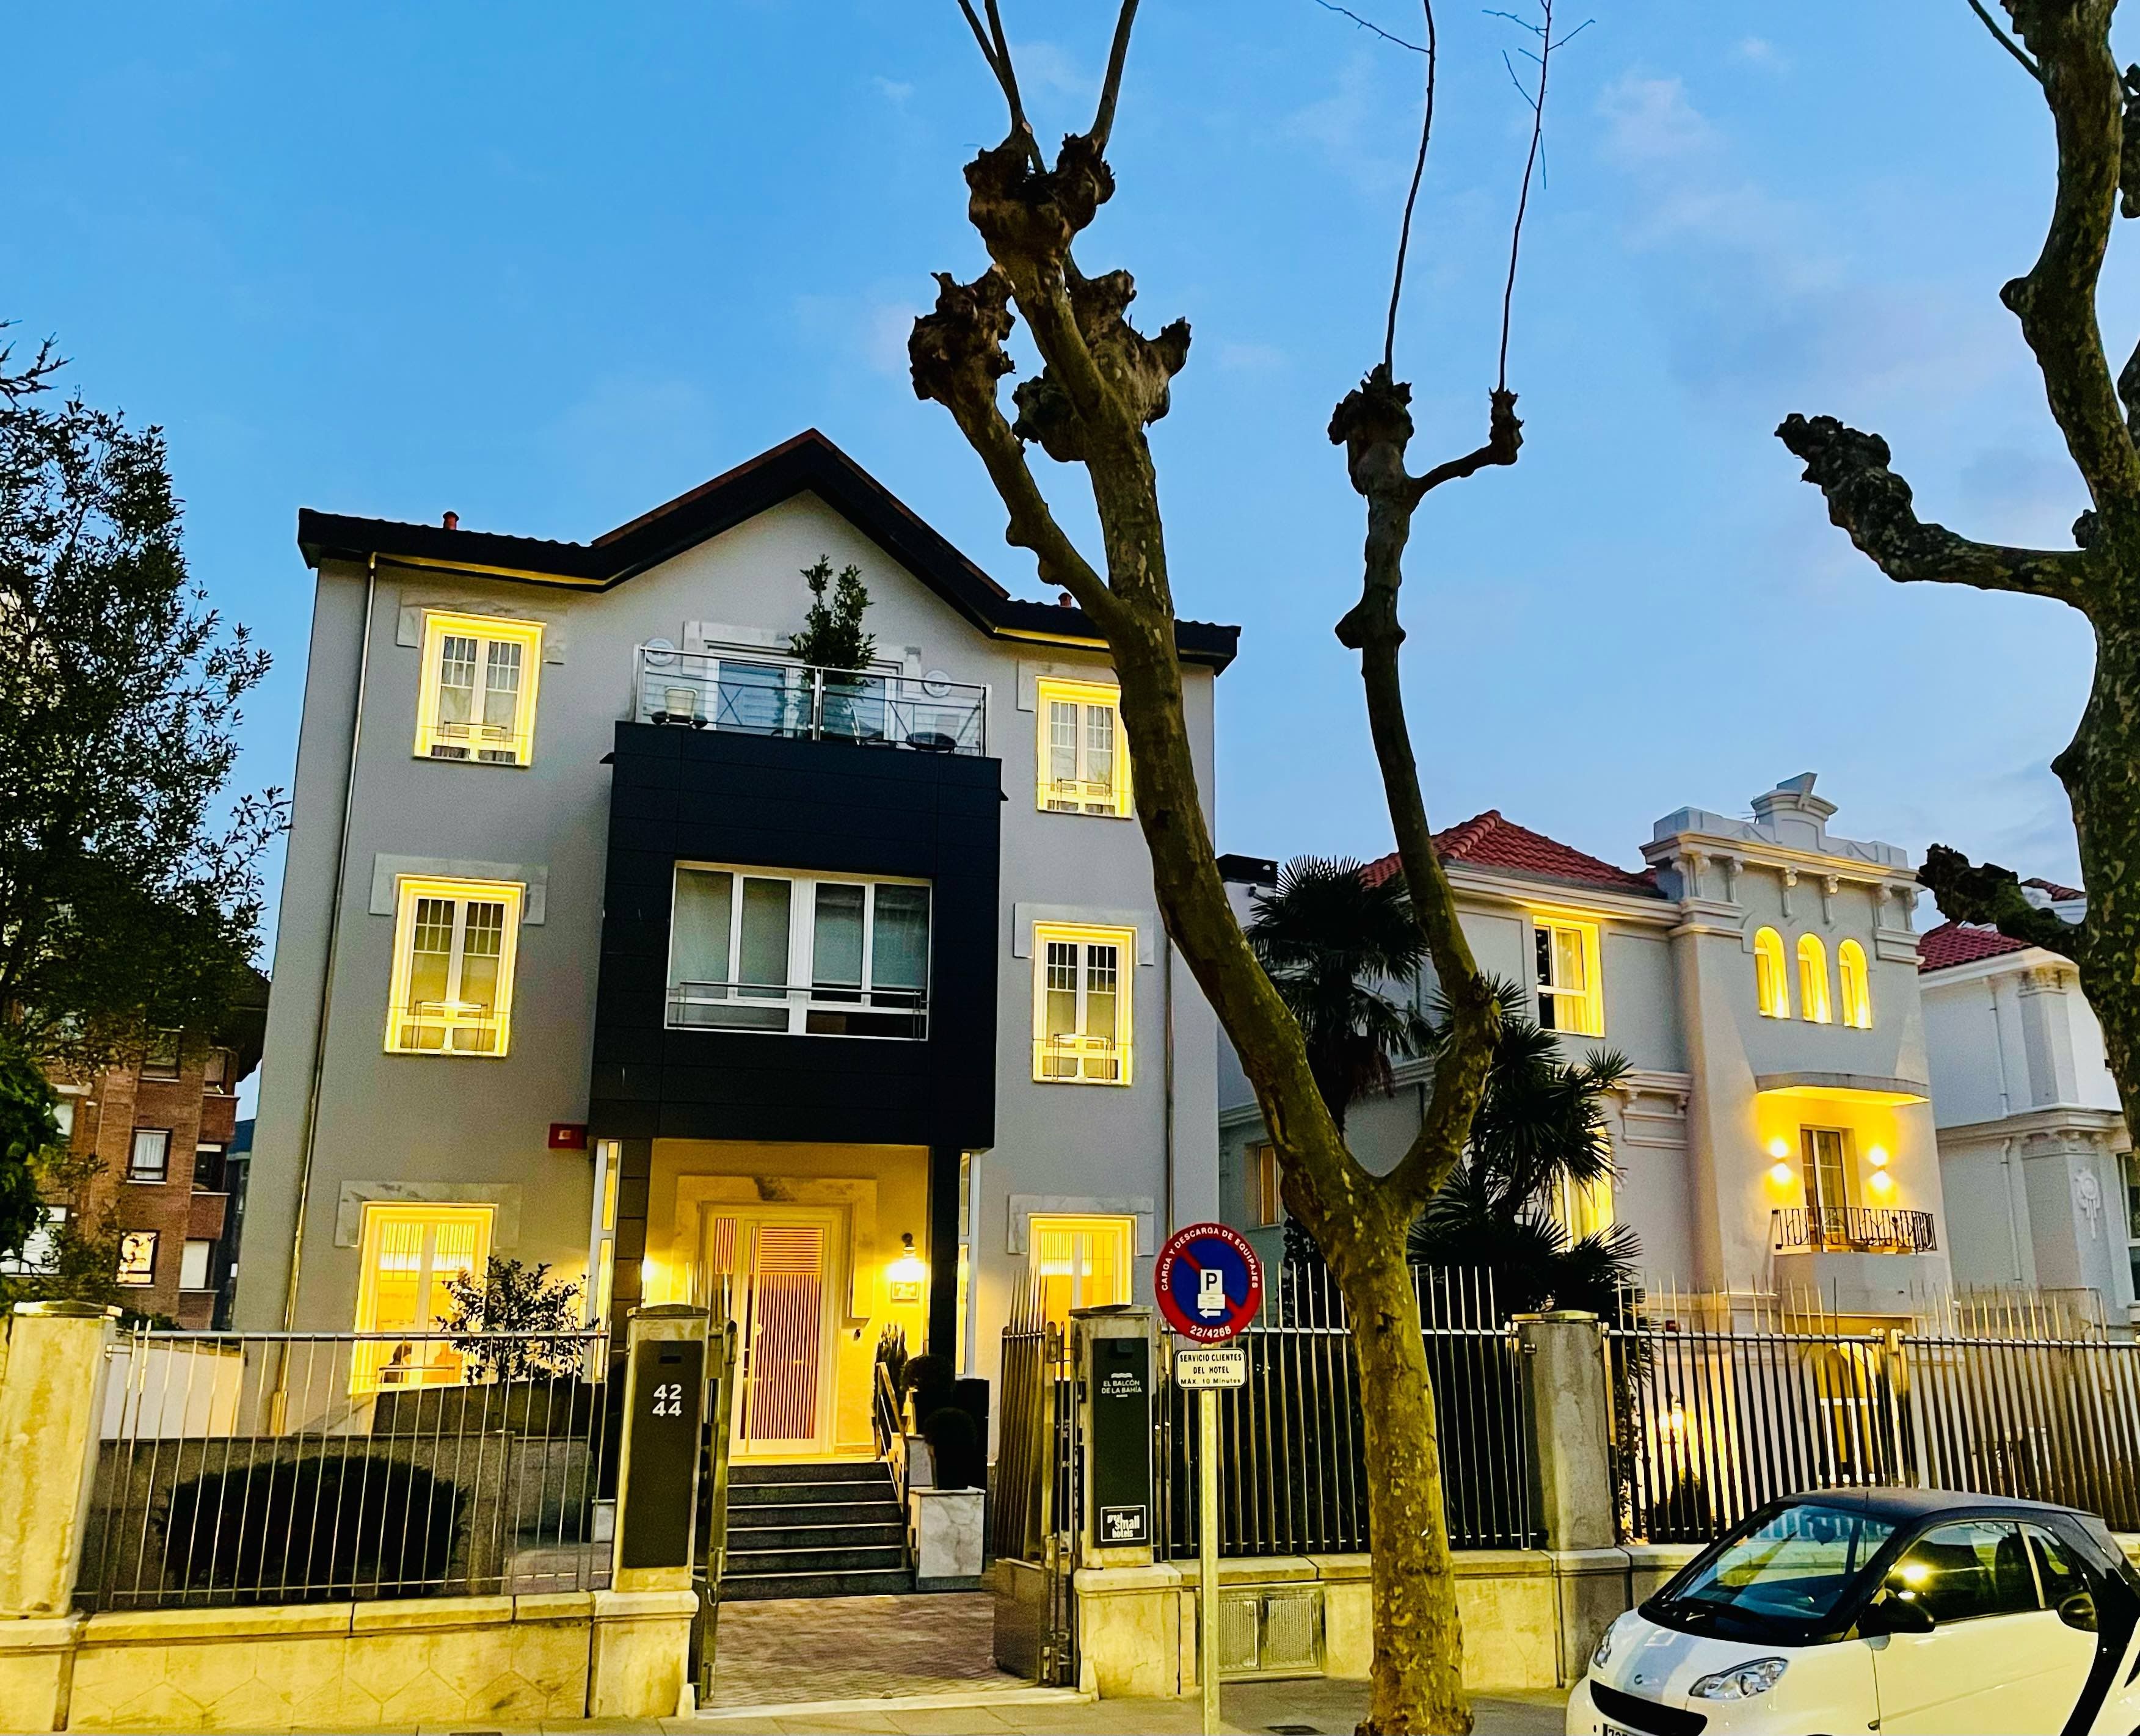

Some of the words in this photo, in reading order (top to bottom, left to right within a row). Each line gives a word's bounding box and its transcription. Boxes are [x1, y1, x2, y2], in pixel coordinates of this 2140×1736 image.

[1161, 1257, 1173, 1291] CARGA
[1174, 1227, 1219, 1249] DESCARGA
[1221, 1230, 1234, 1241] DE
[1234, 1238, 1259, 1288] EQUIPAJES
[1206, 1273, 1217, 1290] P
[1211, 1353, 1242, 1362] CLIENTES
[653, 1384, 682, 1400] 42
[652, 1401, 682, 1417] 44
[1115, 1515, 1140, 1530] small
